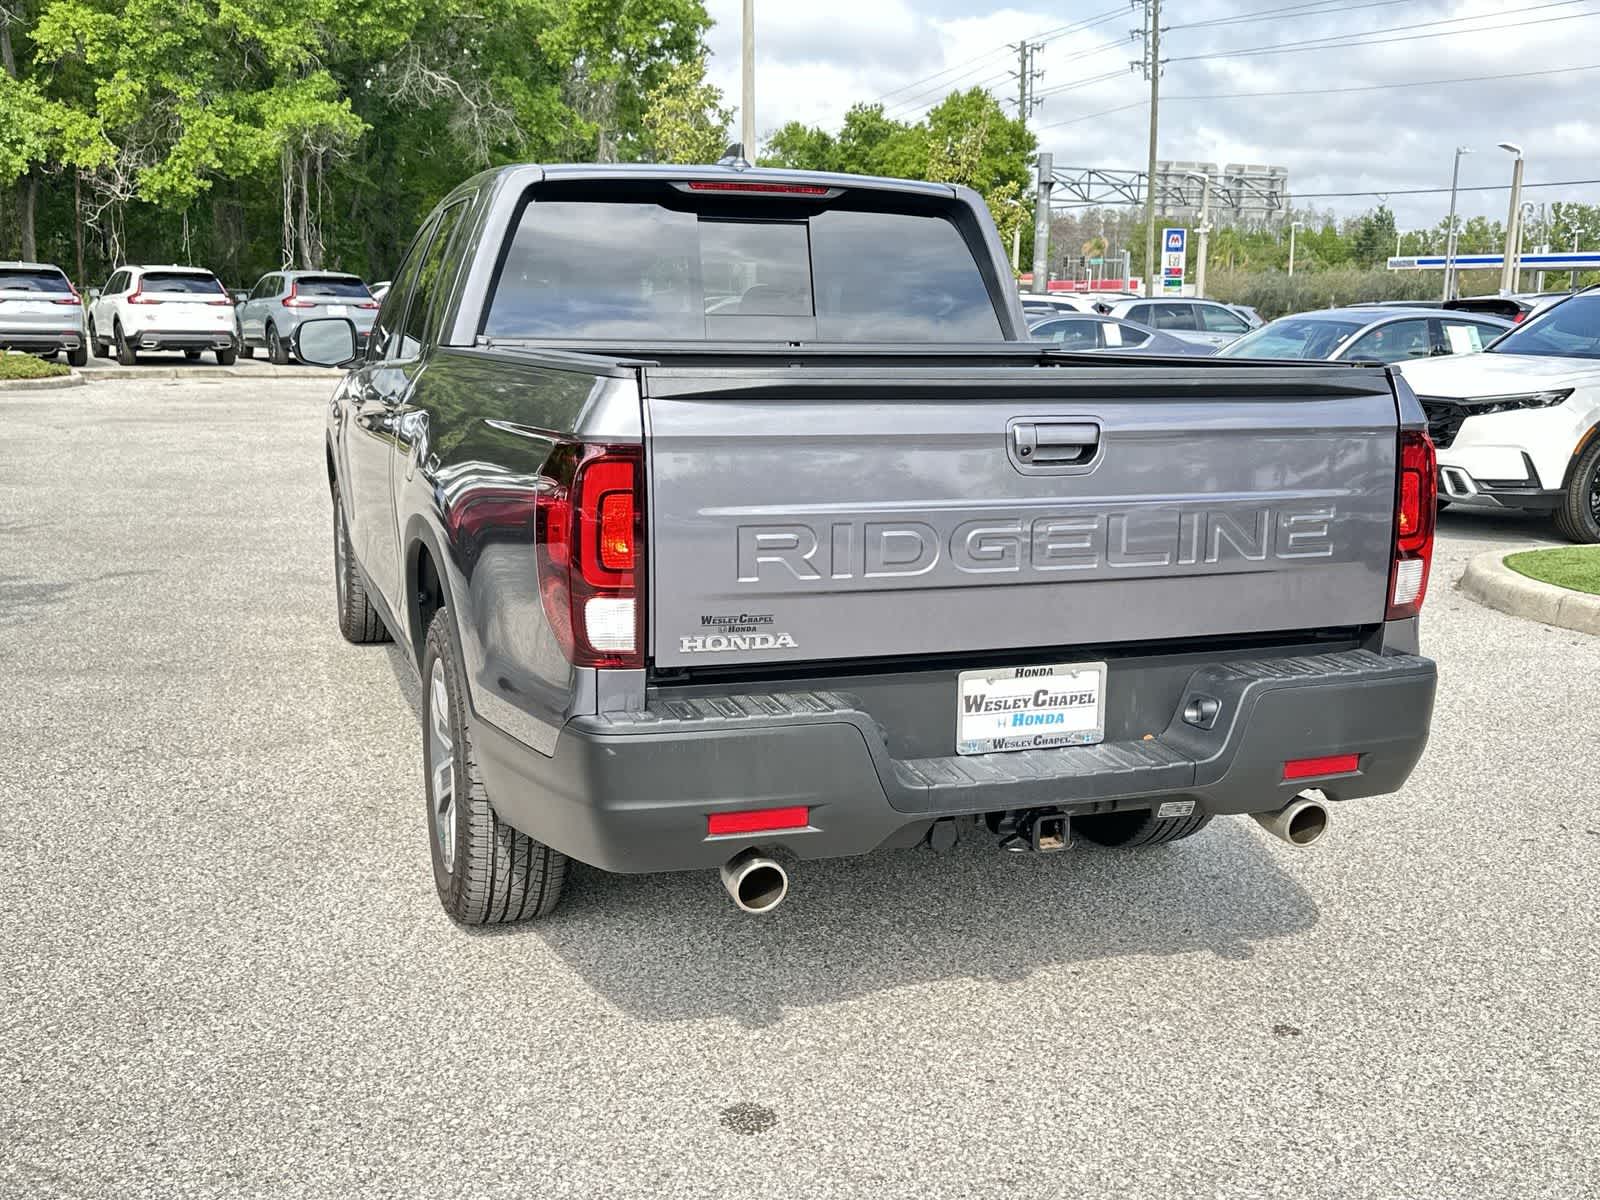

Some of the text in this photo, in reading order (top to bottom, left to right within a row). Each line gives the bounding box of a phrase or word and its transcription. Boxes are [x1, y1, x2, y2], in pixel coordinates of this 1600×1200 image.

[736, 506, 1336, 583] RIDGELINE
[679, 632, 799, 653] HONDA
[1015, 667, 1054, 679] HONDA
[964, 689, 1096, 713] WESLEY CHAPEL
[1011, 712, 1065, 728] HONDA
